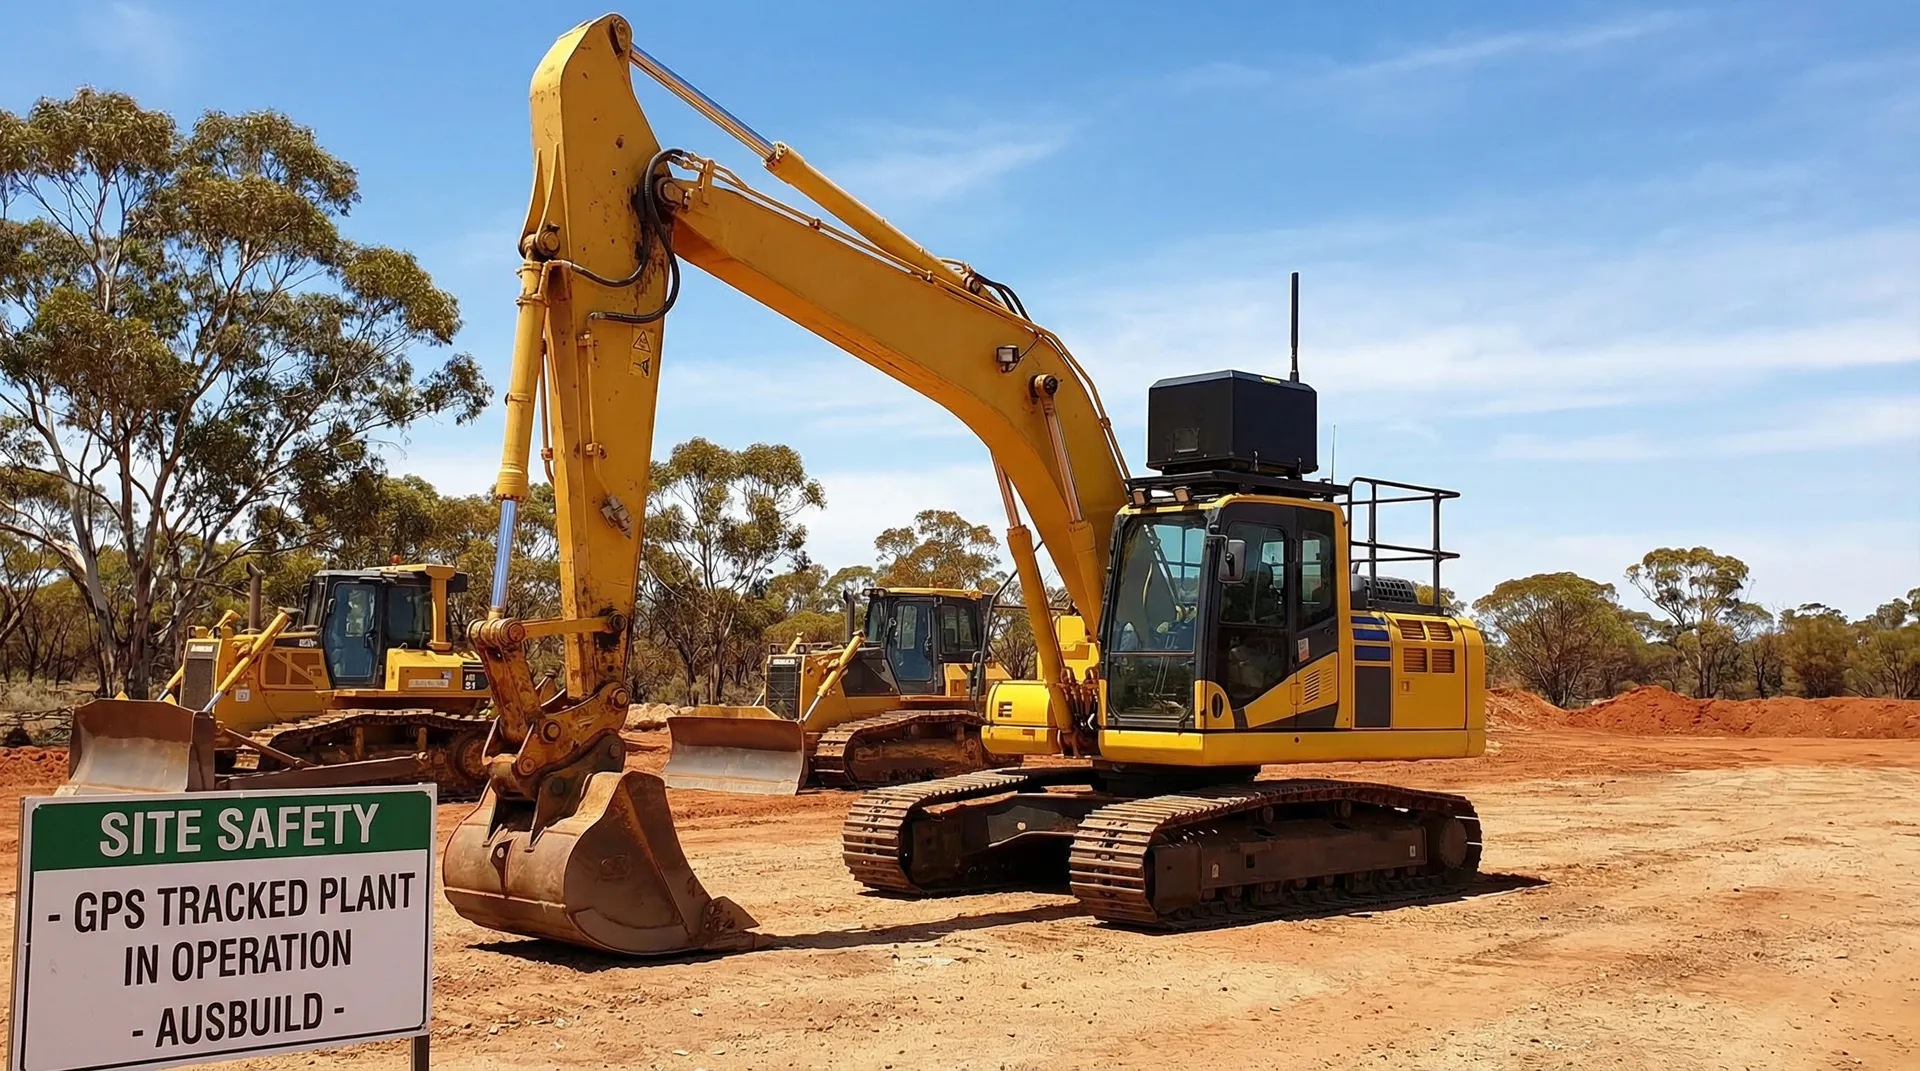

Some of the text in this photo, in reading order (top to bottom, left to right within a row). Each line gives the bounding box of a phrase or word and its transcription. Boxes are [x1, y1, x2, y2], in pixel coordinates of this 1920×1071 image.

[99, 803, 380, 857] SITE SAFETY
[74, 885, 145, 934] GPS
[157, 881, 308, 927] TRACKED
[319, 872, 416, 915] PLANT
[124, 928, 352, 987] IN OPERATION
[155, 992, 323, 1048] AUSBUILD
